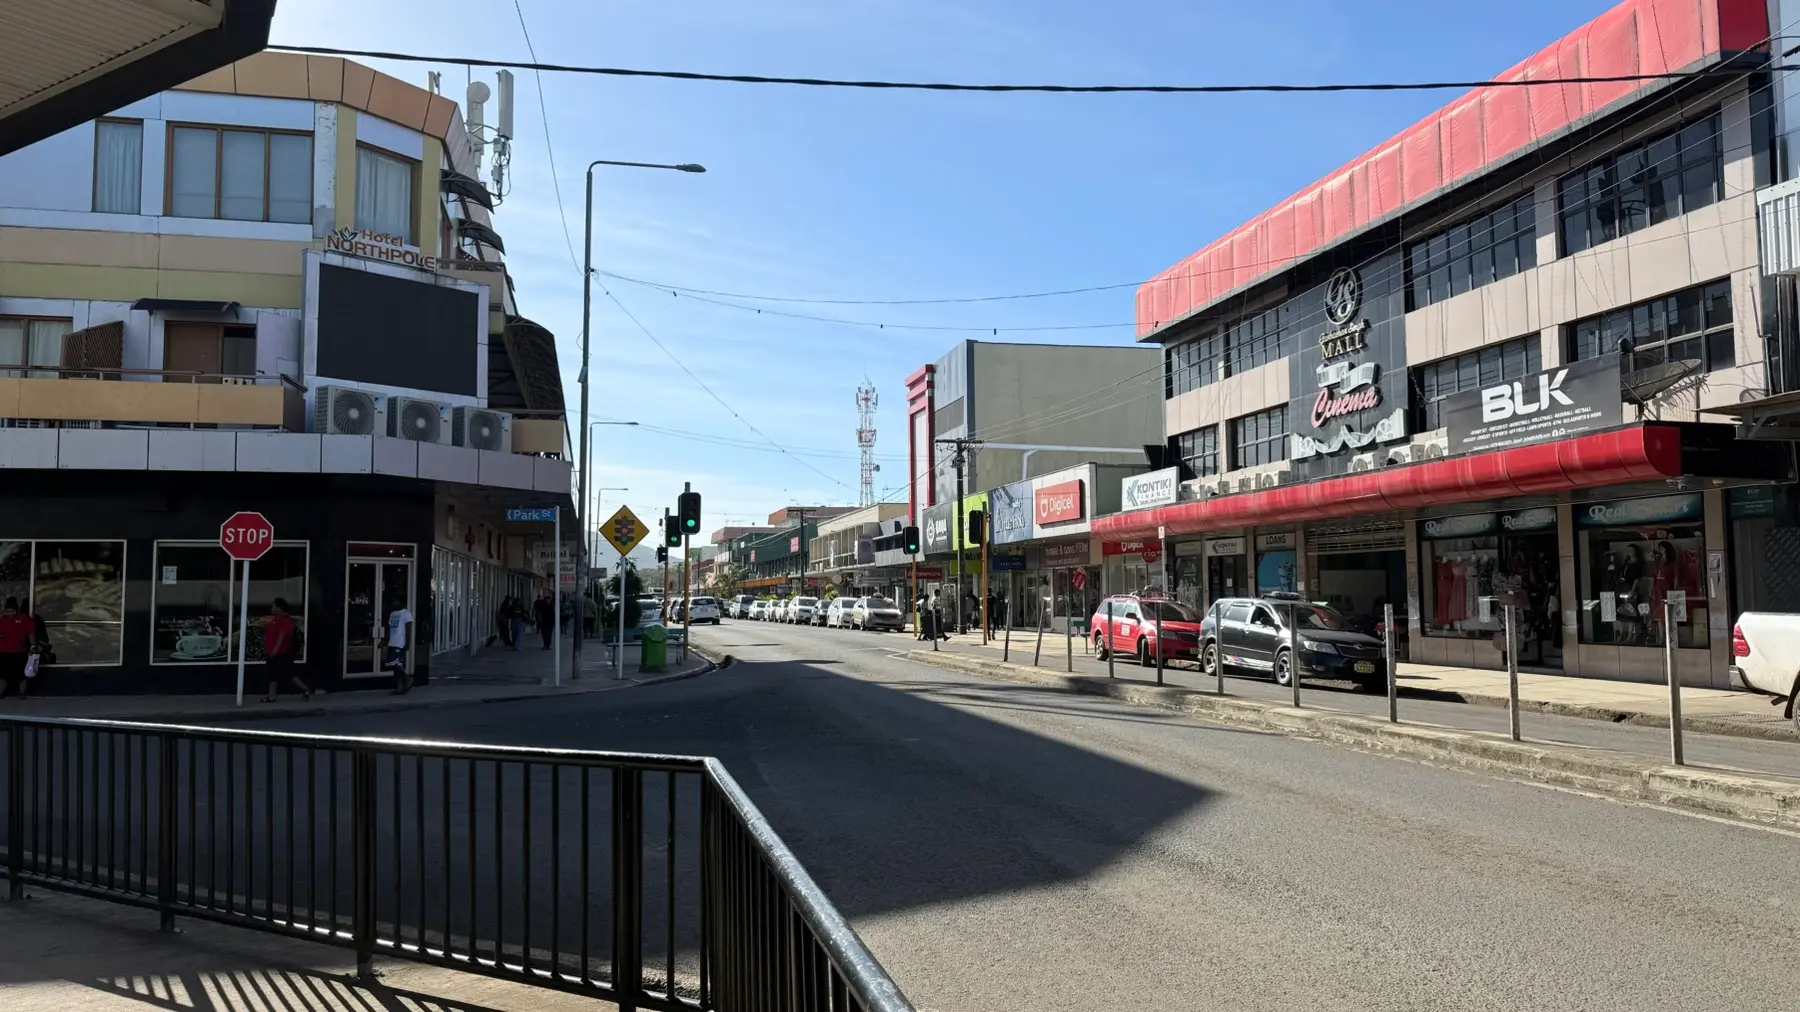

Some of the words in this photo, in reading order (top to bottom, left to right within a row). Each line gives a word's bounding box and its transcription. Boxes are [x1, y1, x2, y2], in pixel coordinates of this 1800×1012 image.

[360, 229, 404, 247] Hotel
[326, 236, 435, 269] NORTHPOLE
[1321, 333, 1363, 360] MALL
[1482, 369, 1575, 423] BLK
[1310, 386, 1378, 428] Cinema
[1137, 478, 1172, 494] KONTIKI
[513, 510, 540, 520] Park
[542, 509, 551, 517] St
[1049, 494, 1074, 516] Digicel
[1589, 503, 1627, 523] Real
[1425, 519, 1448, 536] Real
[1502, 512, 1523, 531] Real
[225, 528, 269, 544] STOP
[1266, 535, 1286, 545] LOANS
